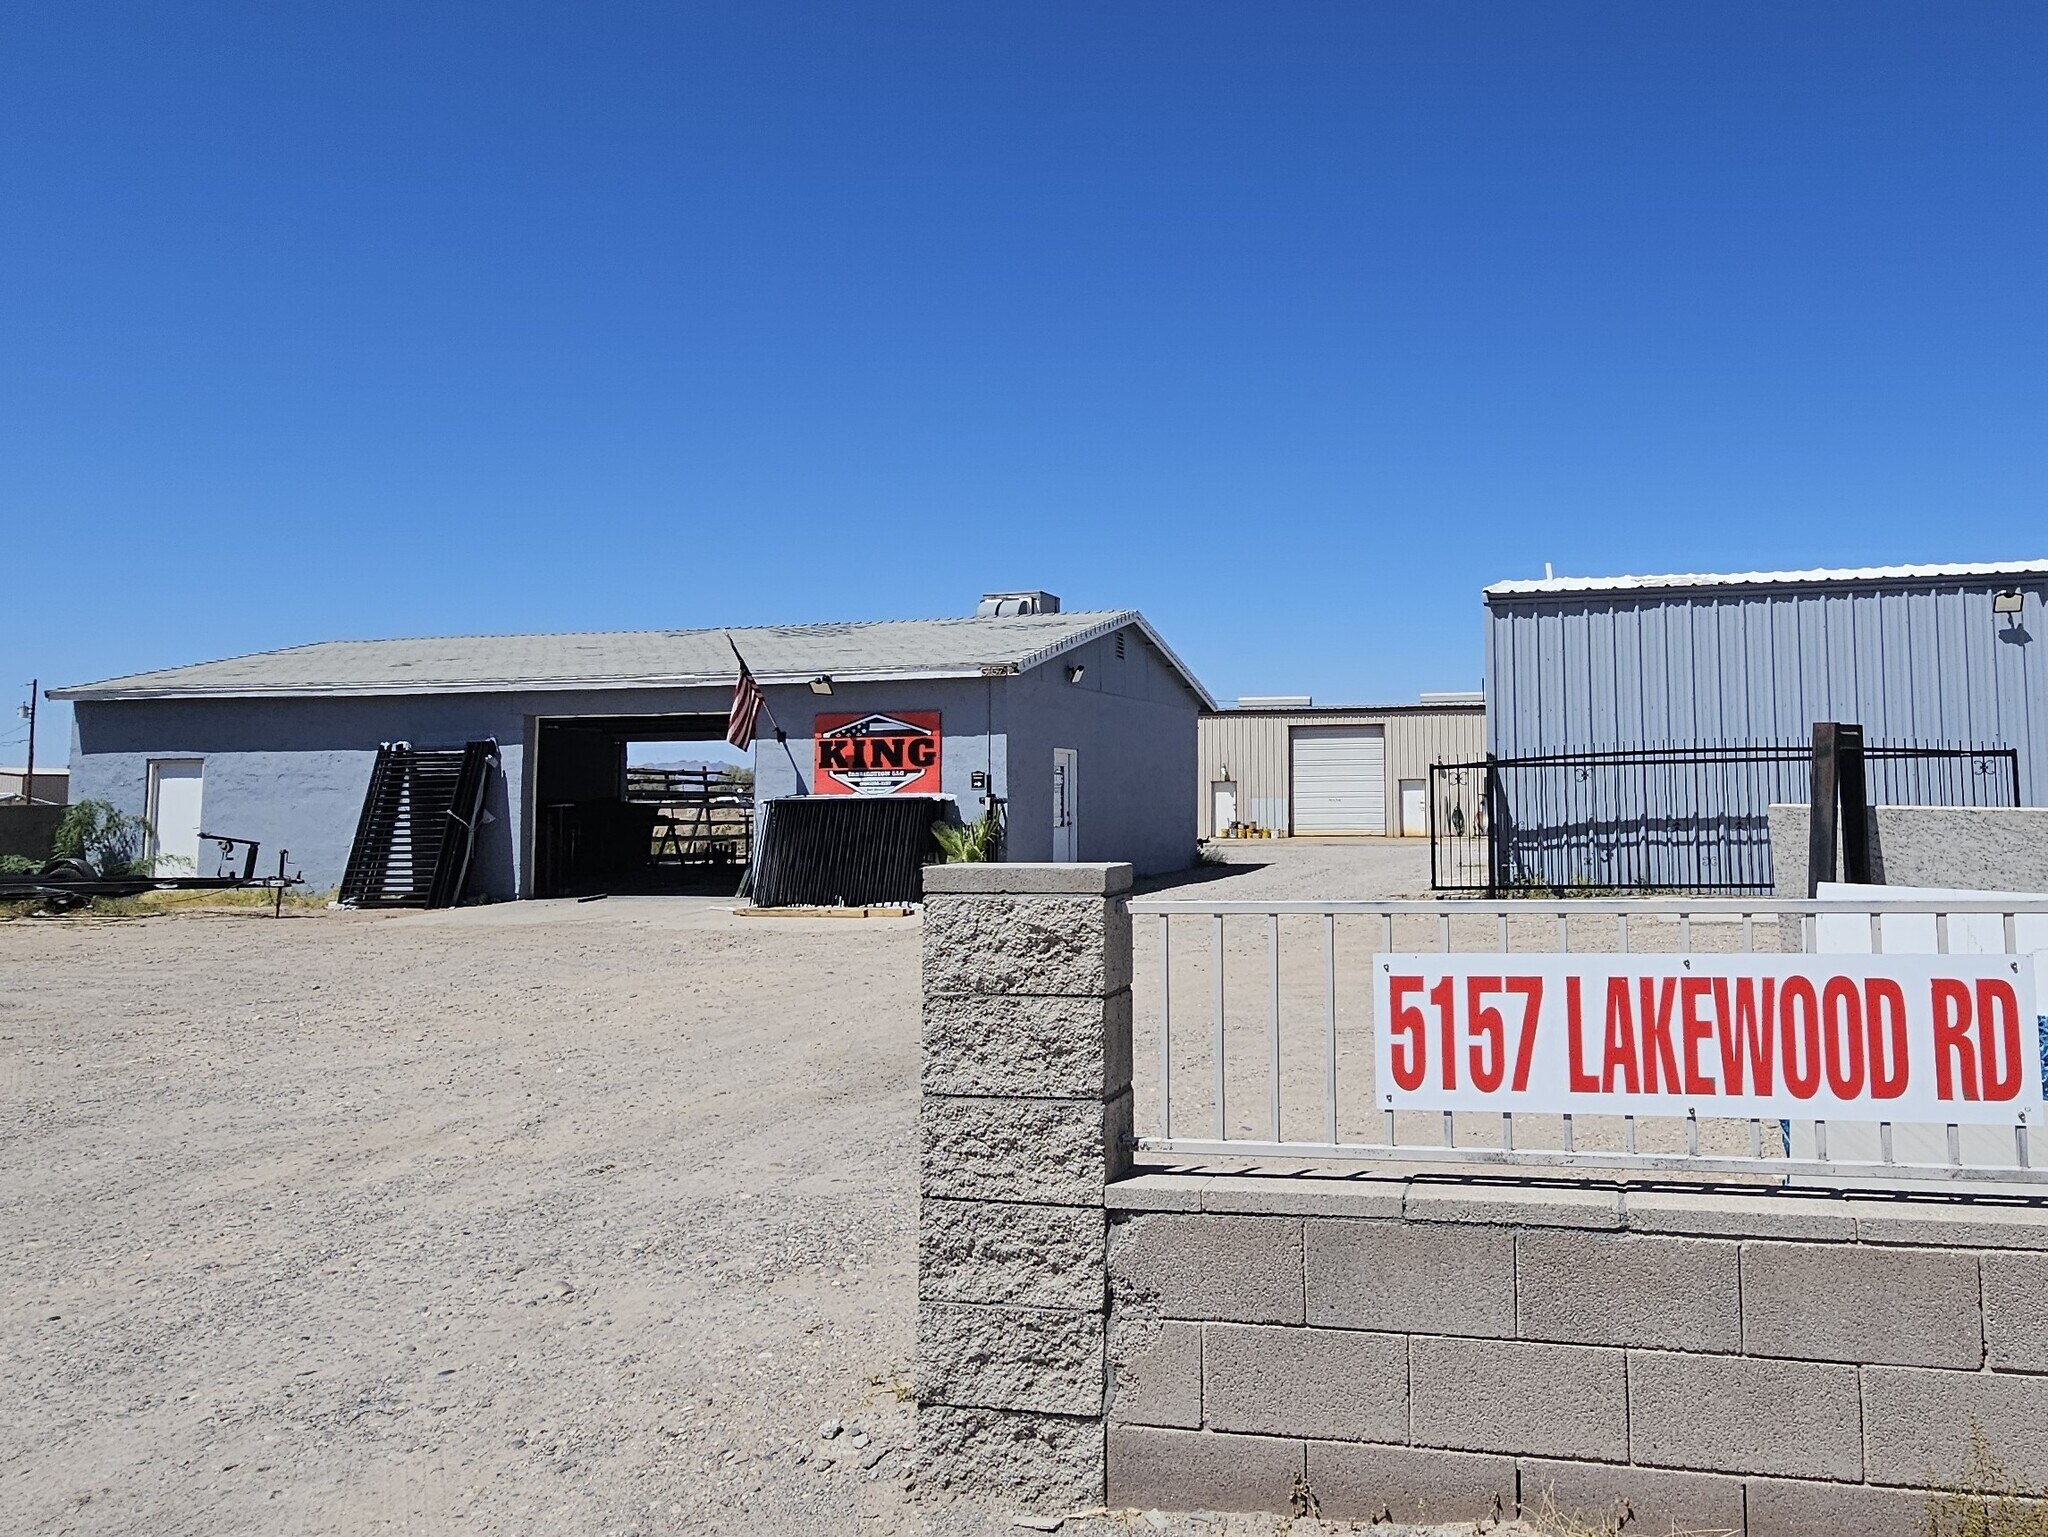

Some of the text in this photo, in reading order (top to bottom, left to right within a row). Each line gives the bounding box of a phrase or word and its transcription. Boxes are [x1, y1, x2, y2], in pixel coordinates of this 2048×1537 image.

[818, 738, 936, 769] KING
[1390, 976, 2024, 1102] 5157 LAKEWOOD RD
